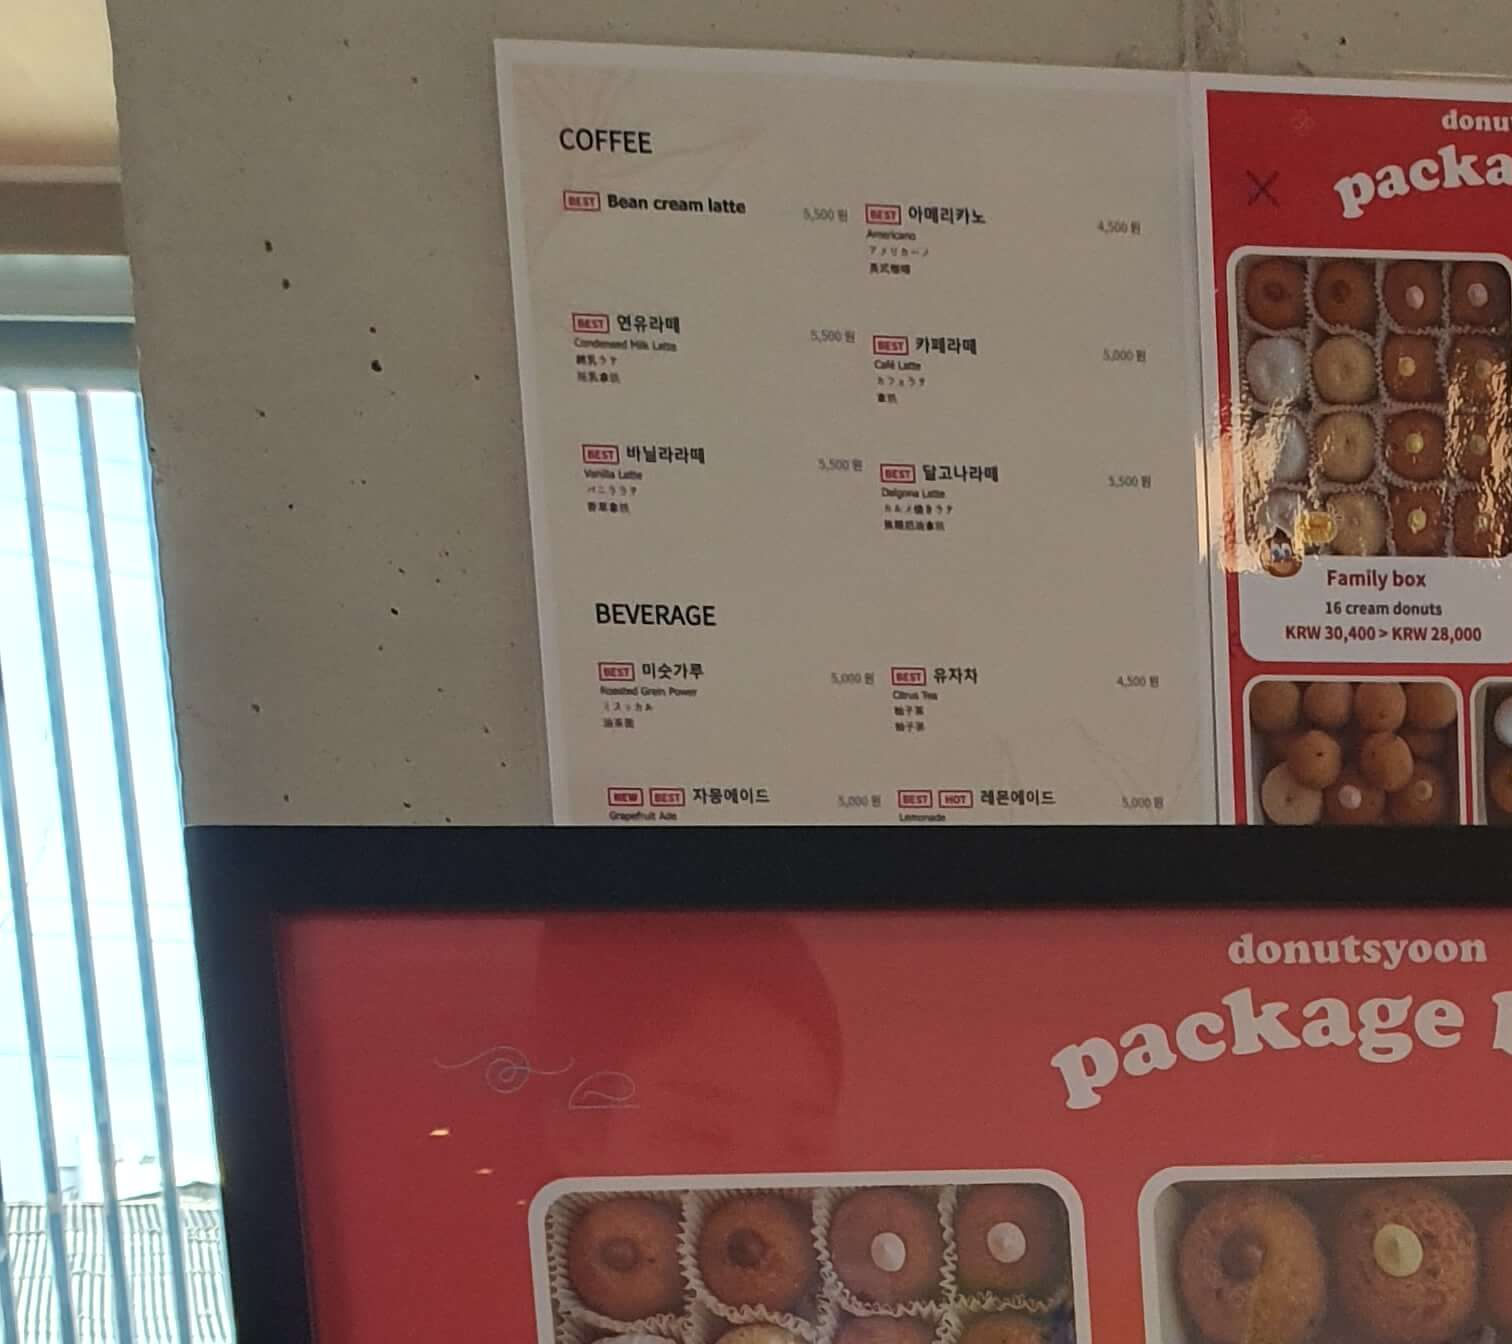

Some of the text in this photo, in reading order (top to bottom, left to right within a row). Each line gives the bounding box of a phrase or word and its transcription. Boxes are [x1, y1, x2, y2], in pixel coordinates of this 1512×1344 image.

[559, 128, 653, 154] COFFEE
[567, 193, 747, 214] BEST Bean cream latte
[869, 205, 987, 224] BEST 아메리카노
[1326, 569, 1427, 591] Family box
[595, 603, 717, 627] BEVERAGE
[1325, 601, 1443, 616] 16 cream donuts
[1285, 625, 1482, 645] KRW 30,400 KRW 28,000
[641, 662, 705, 680] 미숫가루
[933, 667, 978, 685] 유자차
[692, 787, 771, 805] 자몽에이드
[979, 789, 1057, 806] 레몬에이드
[1228, 933, 1487, 970] donutsyoon
[1050, 987, 1465, 1110] package
